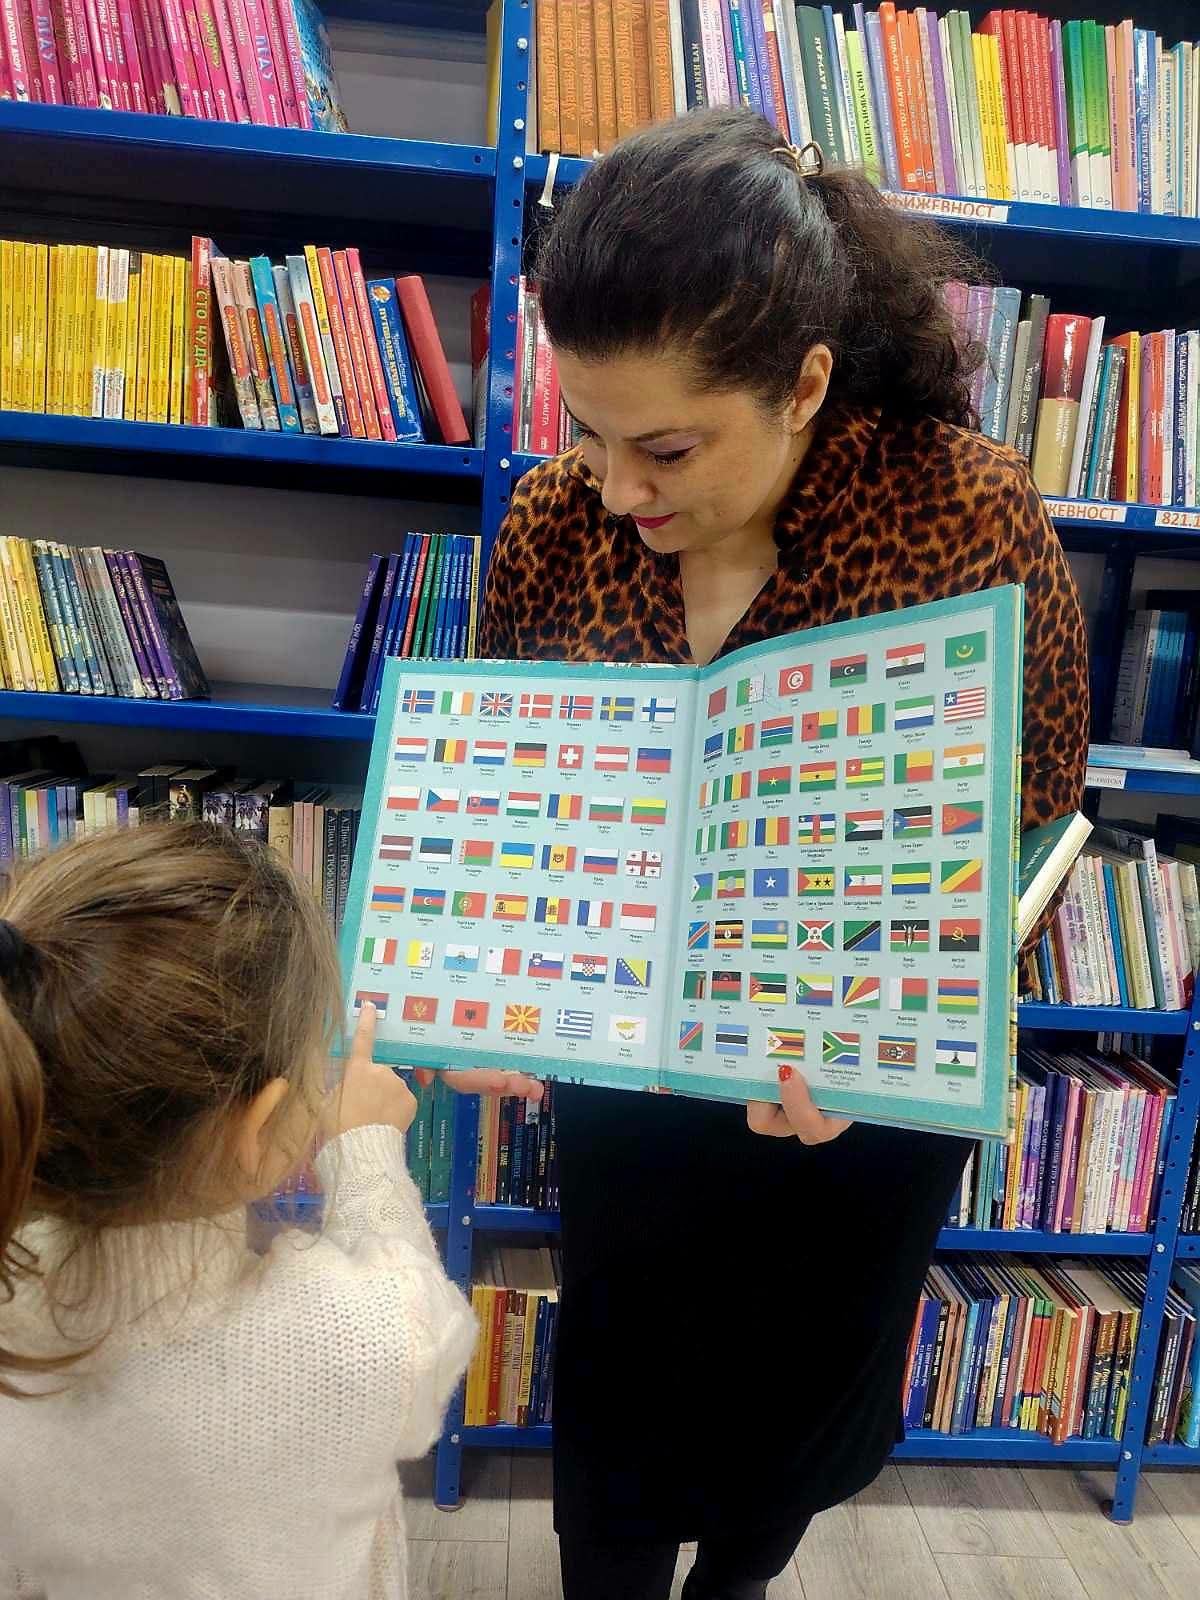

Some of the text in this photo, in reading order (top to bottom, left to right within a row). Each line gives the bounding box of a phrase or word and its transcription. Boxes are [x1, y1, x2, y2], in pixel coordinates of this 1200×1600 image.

[195, 289, 207, 319] СТО
[195, 323, 208, 369] ЧУДА
[377, 307, 395, 360] ПУТОВАЊЕ
